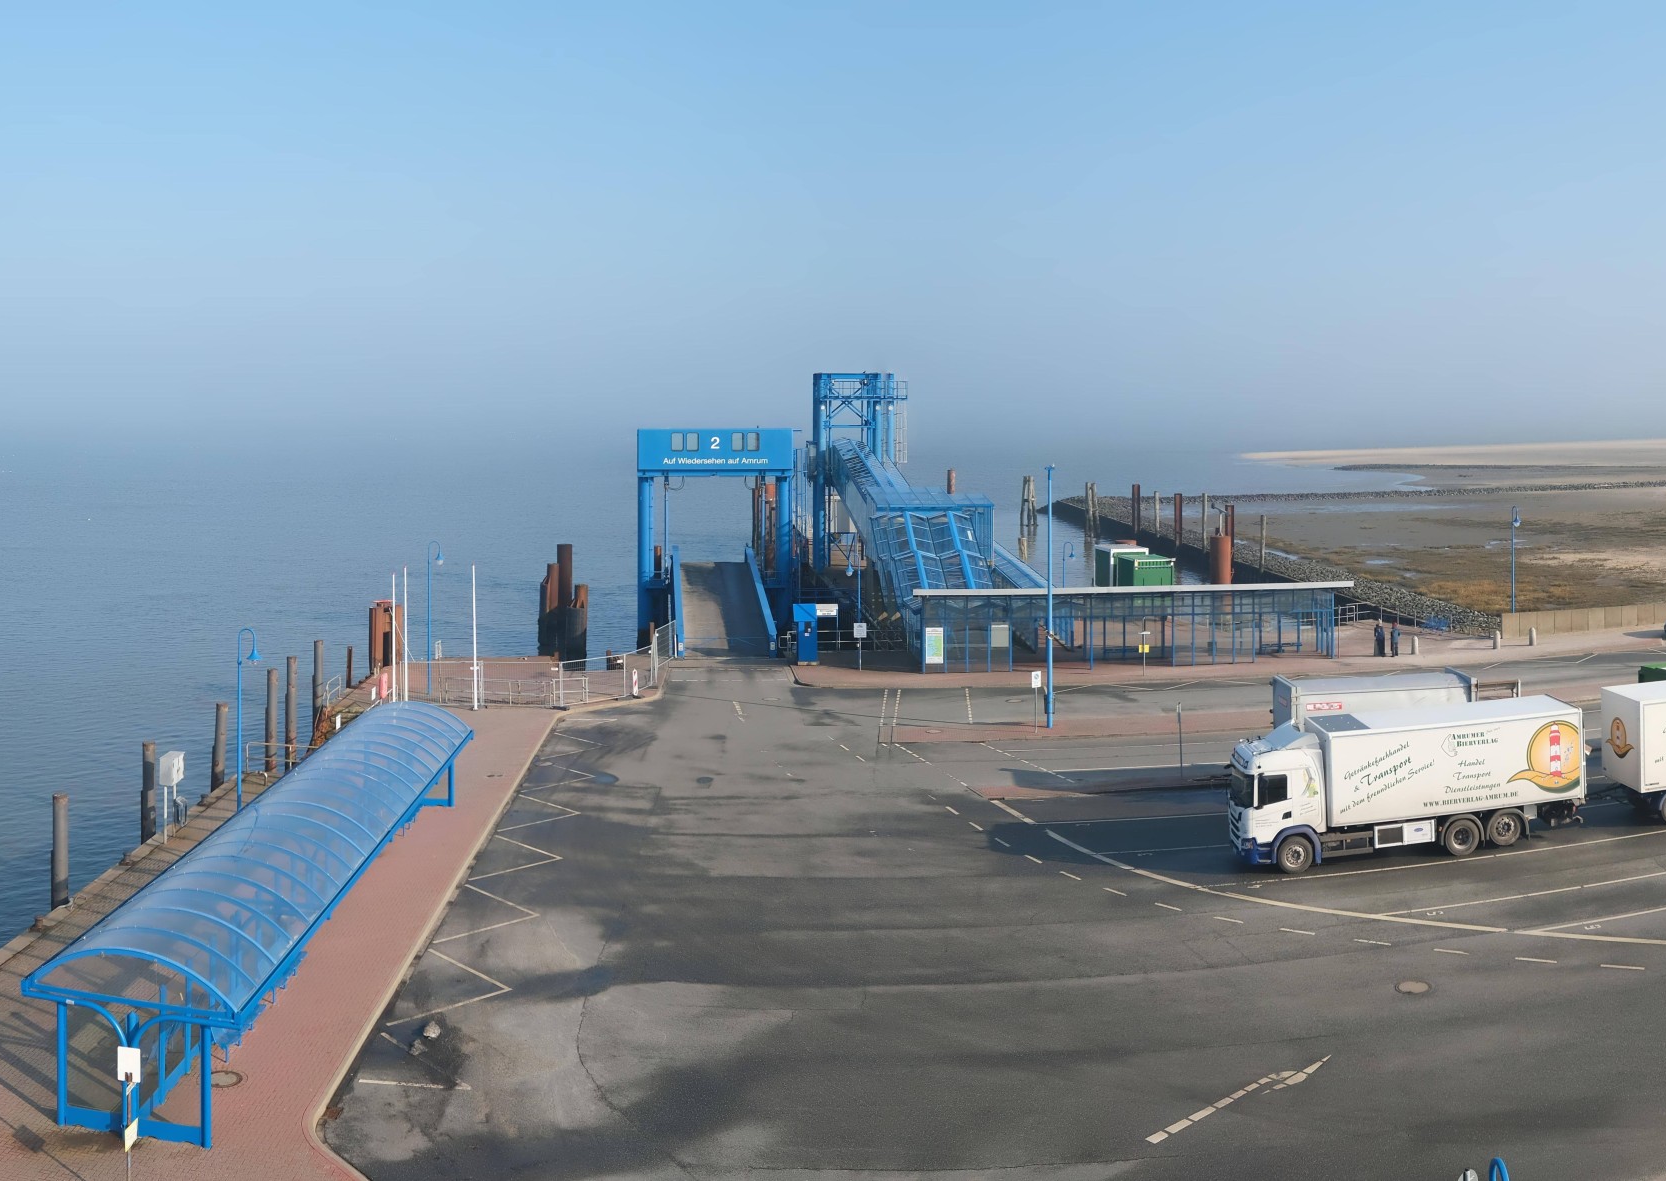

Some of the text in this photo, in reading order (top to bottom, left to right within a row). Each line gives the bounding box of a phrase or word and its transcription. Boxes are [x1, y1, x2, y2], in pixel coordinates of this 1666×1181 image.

[710, 436, 720, 449] 2
[663, 457, 769, 465] Auf Wiedersehen auf Amrum
[1451, 731, 1485, 741] AMRUMER
[1456, 738, 1499, 748] BIERVERLAG
[1457, 758, 1486, 768] Handel
[1359, 756, 1412, 786] Transport
[1452, 771, 1492, 781] Transport
[1339, 758, 1435, 814] mit dem freundlichen Service!
[1444, 782, 1501, 794] Dienstleistungen
[1423, 791, 1519, 808] WWW.BIERVERLAG-AMRUM.DE
